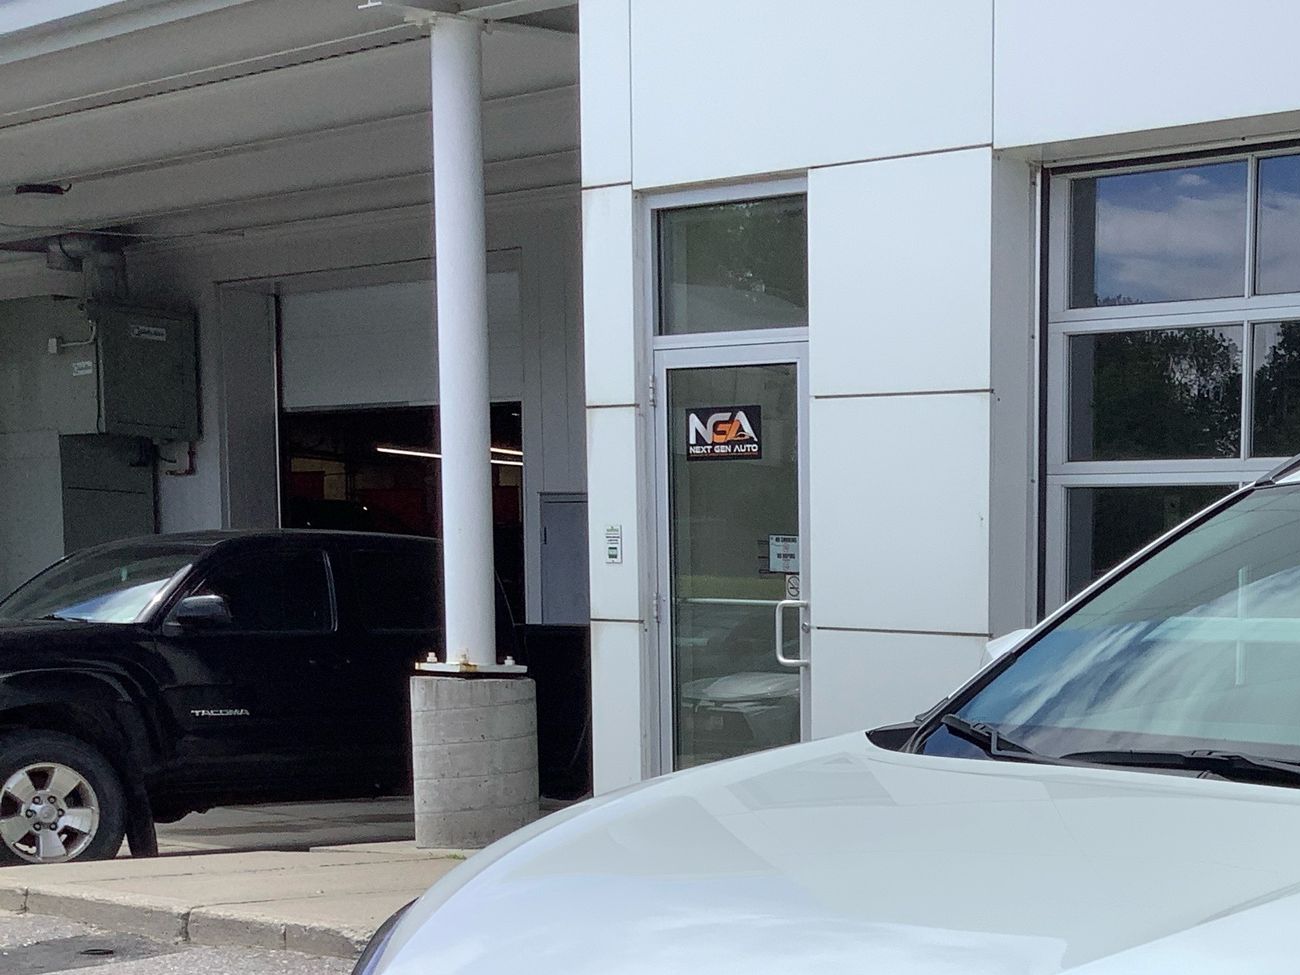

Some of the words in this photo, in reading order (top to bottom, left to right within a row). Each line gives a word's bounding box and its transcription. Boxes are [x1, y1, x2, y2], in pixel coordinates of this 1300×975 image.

[689, 411, 758, 444] NGA
[689, 445, 713, 454] NEXT
[714, 445, 731, 453] GEN
[733, 444, 758, 452] AUTO
